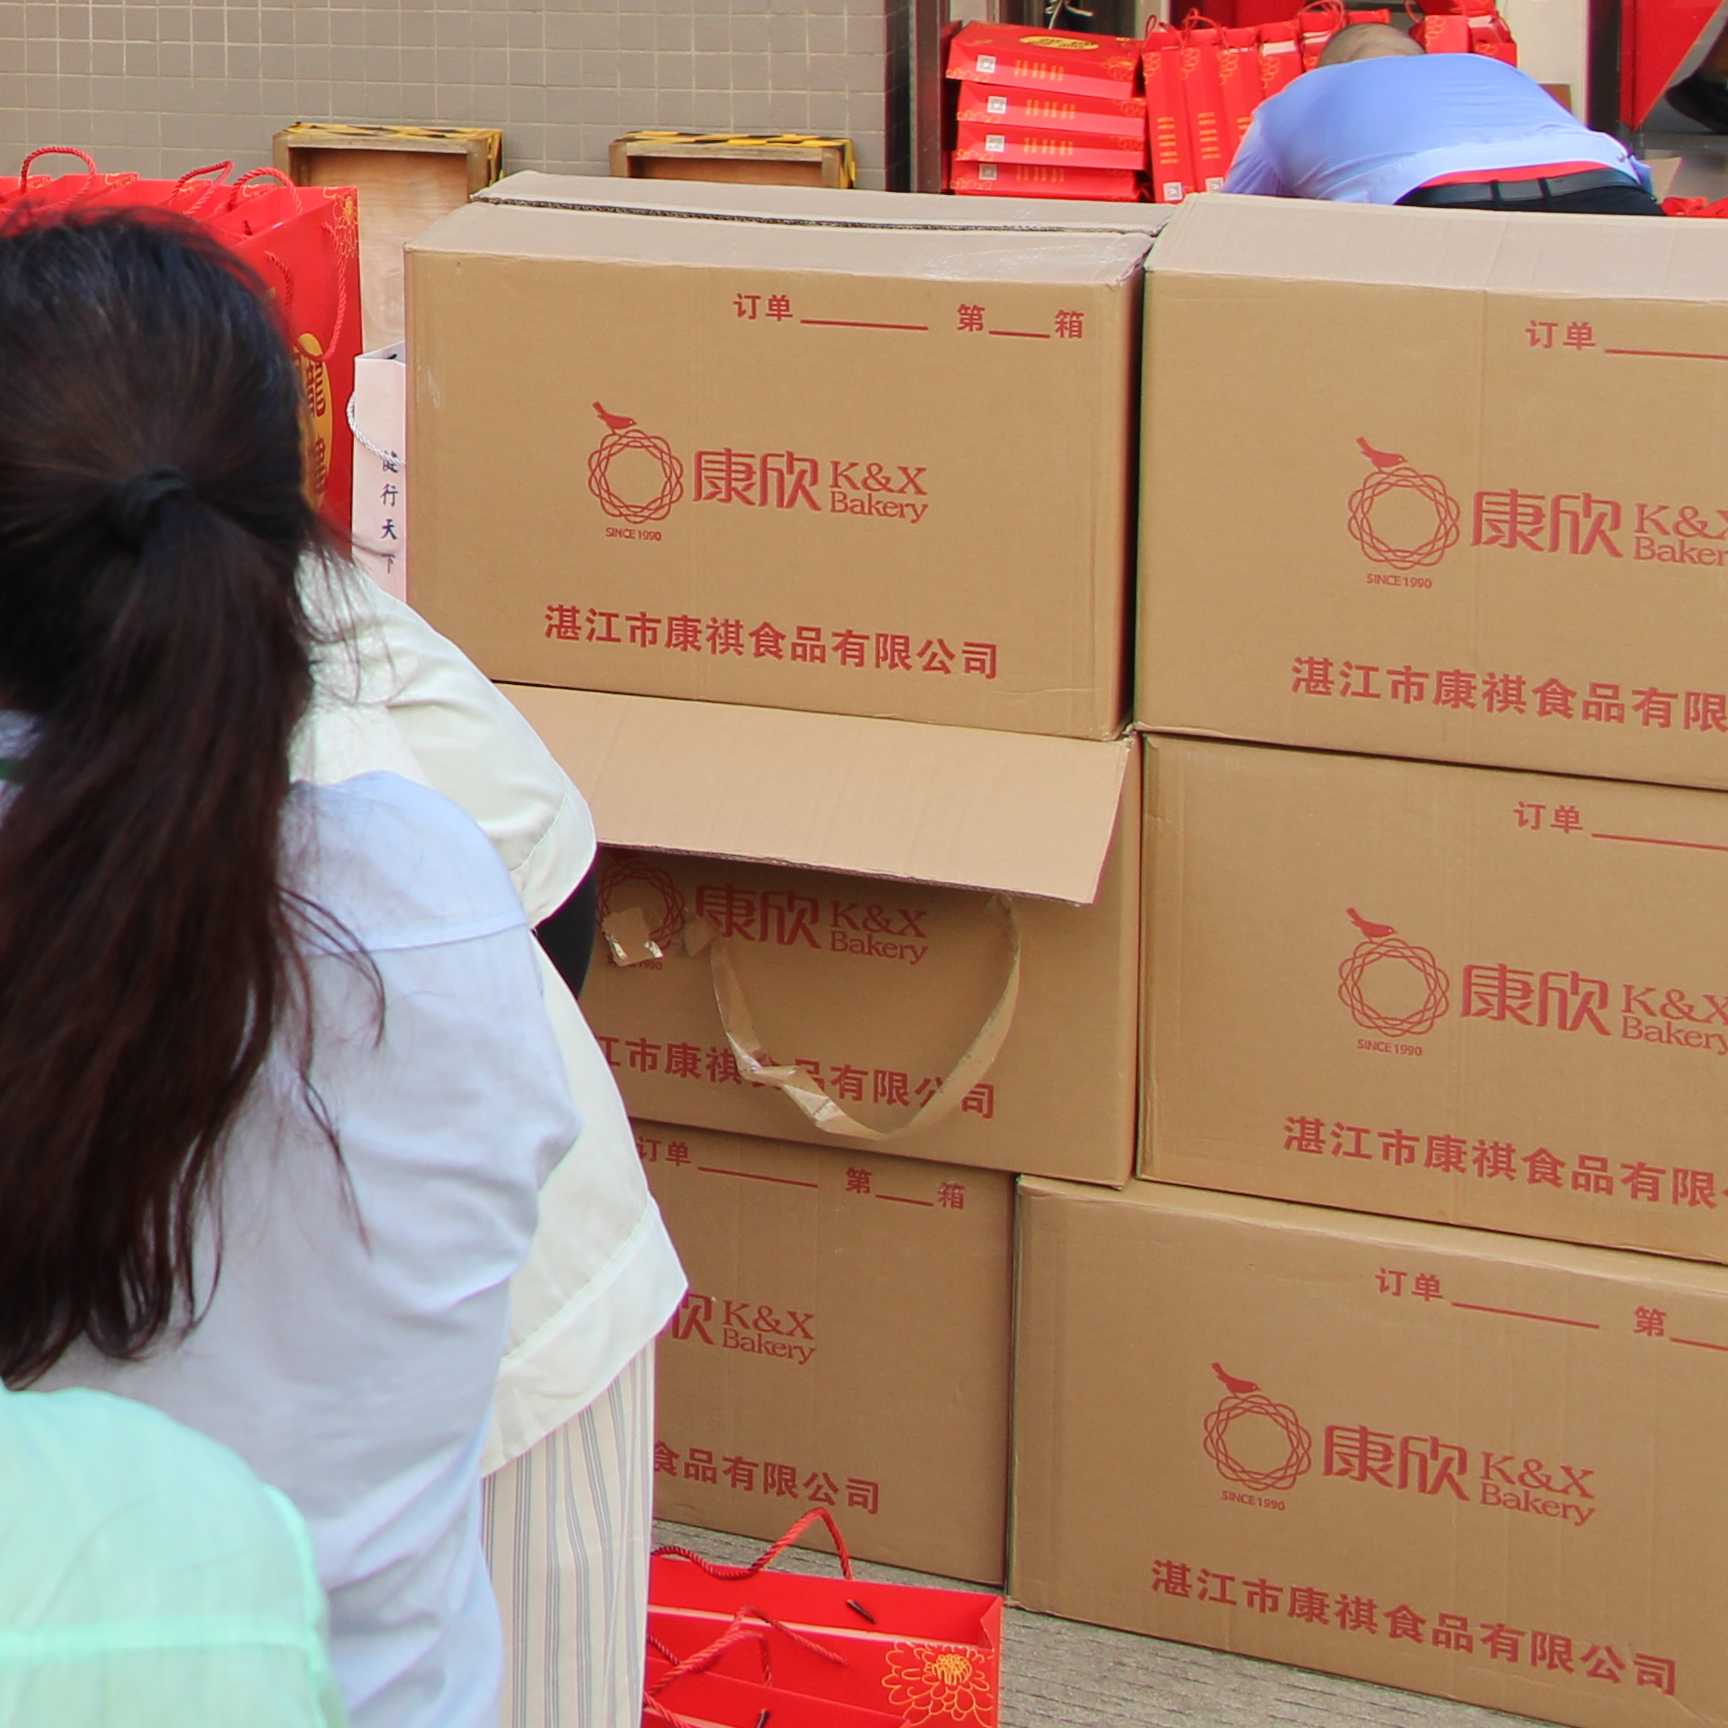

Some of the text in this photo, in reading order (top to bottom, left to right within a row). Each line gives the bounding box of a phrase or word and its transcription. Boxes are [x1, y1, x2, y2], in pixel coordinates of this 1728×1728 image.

[733, 293, 1085, 339] 订单 第 箱
[1525, 320, 1596, 351] 订单
[693, 447, 929, 512] 康欣 K&X
[830, 490, 929, 524] Bakery
[1471, 488, 1624, 558] 康欣
[605, 526, 662, 542] SINCE 1990
[1366, 573, 1432, 590] SINCE 1990
[544, 603, 998, 680] 湛江市康祺食品有限公司
[1291, 656, 1728, 733] 湛江市康祺食品有限
[1514, 802, 1583, 834] 订单
[695, 883, 927, 950] 康欣 K&X
[830, 929, 928, 965] Bakery
[1460, 963, 1728, 1036] 康欣 K&X
[1357, 1039, 1423, 1057] SINCE 1990
[638, 1135, 966, 1210] 订单 第 箱
[1283, 1115, 1728, 1210] 湛江市康祺食品有限
[722, 1299, 815, 1341] K&X
[1375, 1268, 1667, 1339] 订单 第
[721, 1327, 816, 1365] Bakery
[1322, 1424, 1595, 1502] 康欣 K&X
[1222, 1489, 1286, 1512] SINCE 1990
[1480, 1483, 1596, 1527] Bakery
[1151, 1559, 1677, 1696] 湛江市康祺食品有限公司
